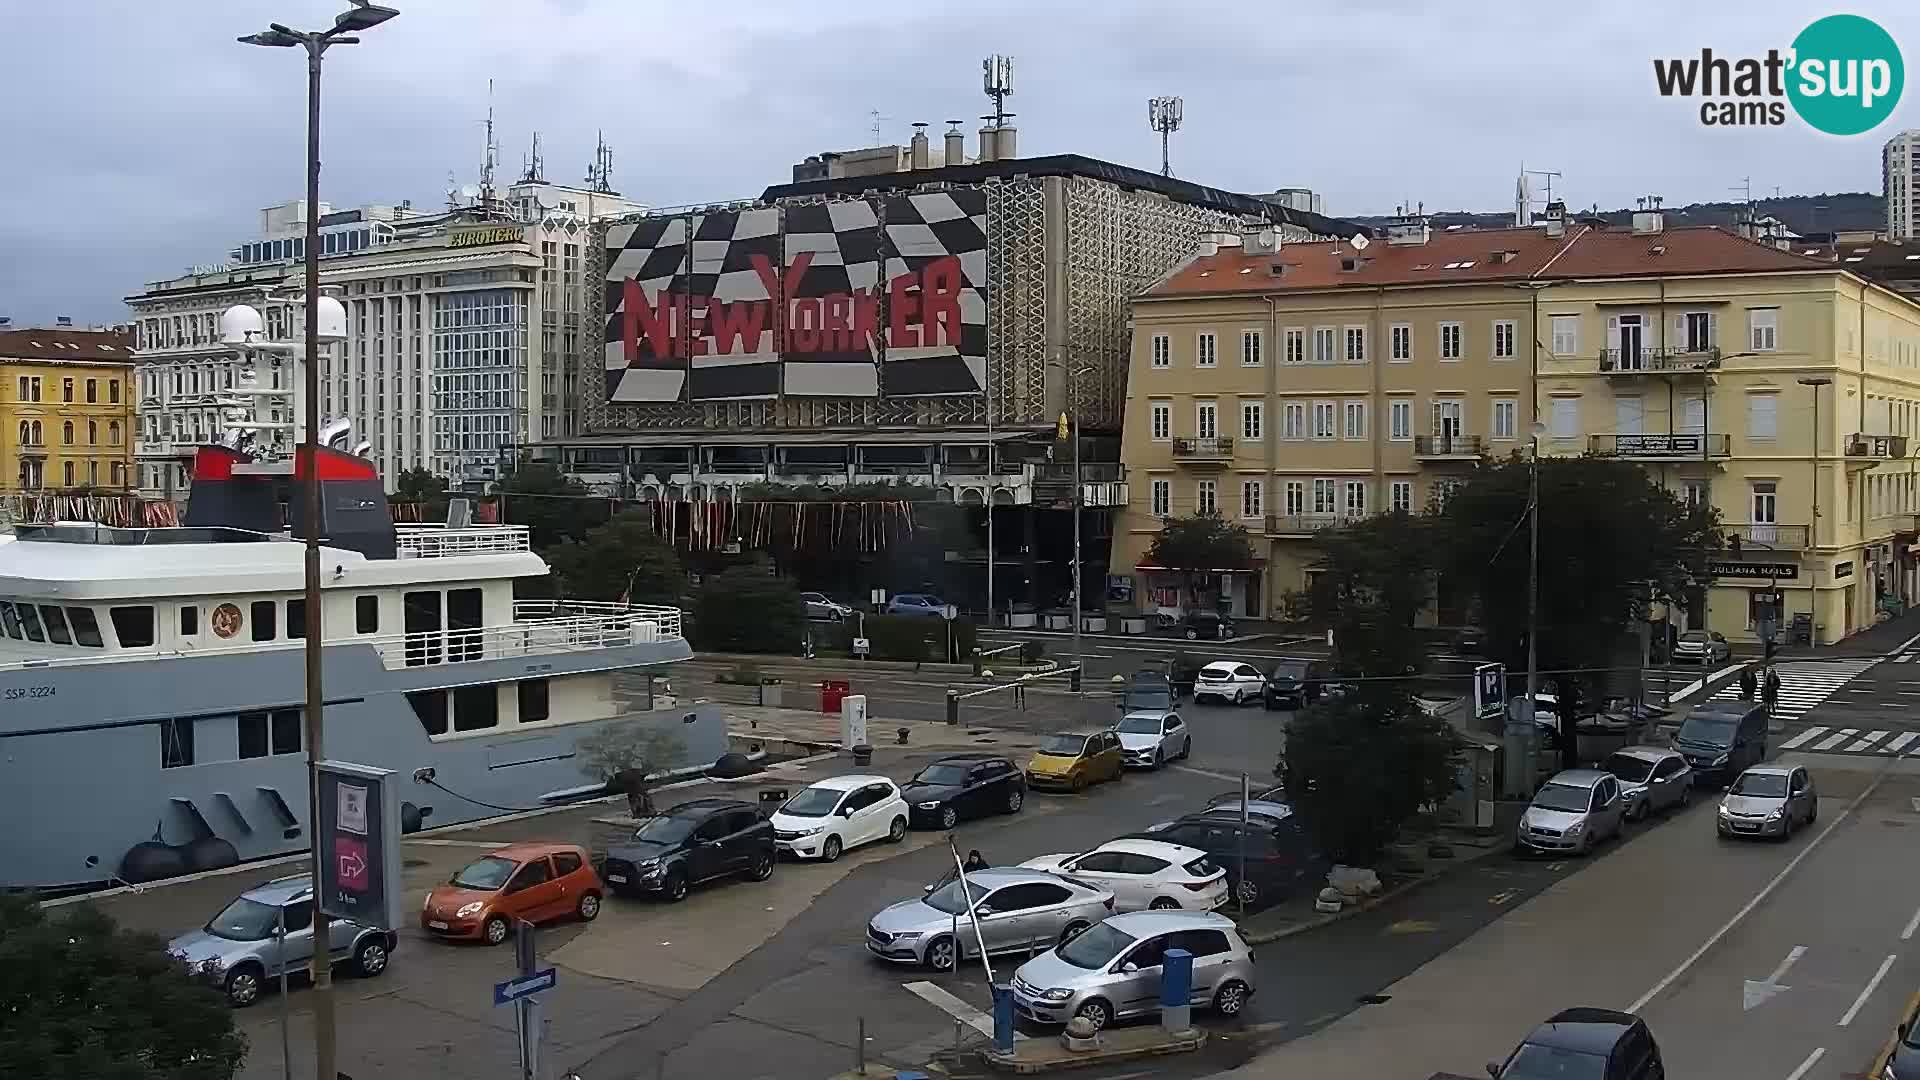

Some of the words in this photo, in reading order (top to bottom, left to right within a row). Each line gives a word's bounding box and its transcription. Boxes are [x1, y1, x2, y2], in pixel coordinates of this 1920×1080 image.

[624, 275, 765, 361] NEW
[5, 688, 25, 700] SSR
[30, 686, 56, 698] 5224
